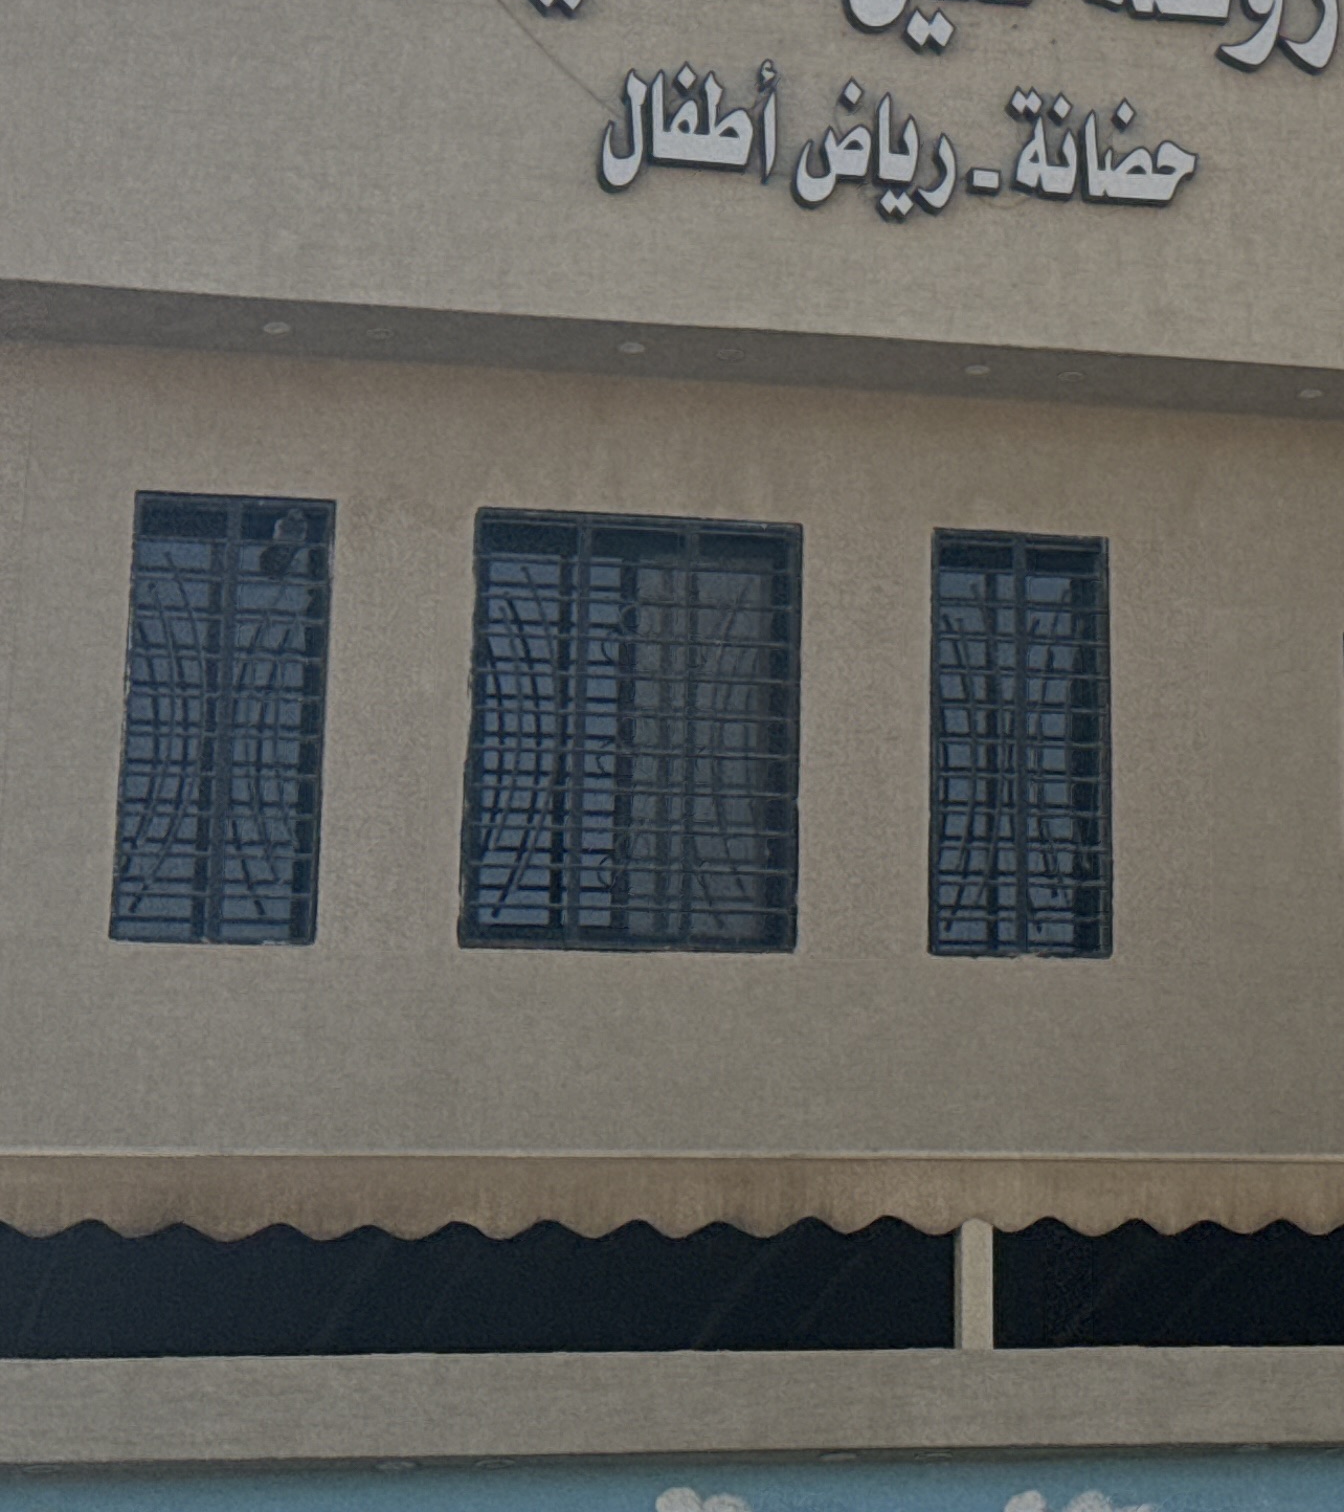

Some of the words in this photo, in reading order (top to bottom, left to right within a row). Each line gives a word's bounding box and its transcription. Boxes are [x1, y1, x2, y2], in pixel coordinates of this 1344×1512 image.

[598, 59, 779, 192] أطفال
[792, 78, 957, 221] رياض
[1006, 87, 1198, 206] حضانة
